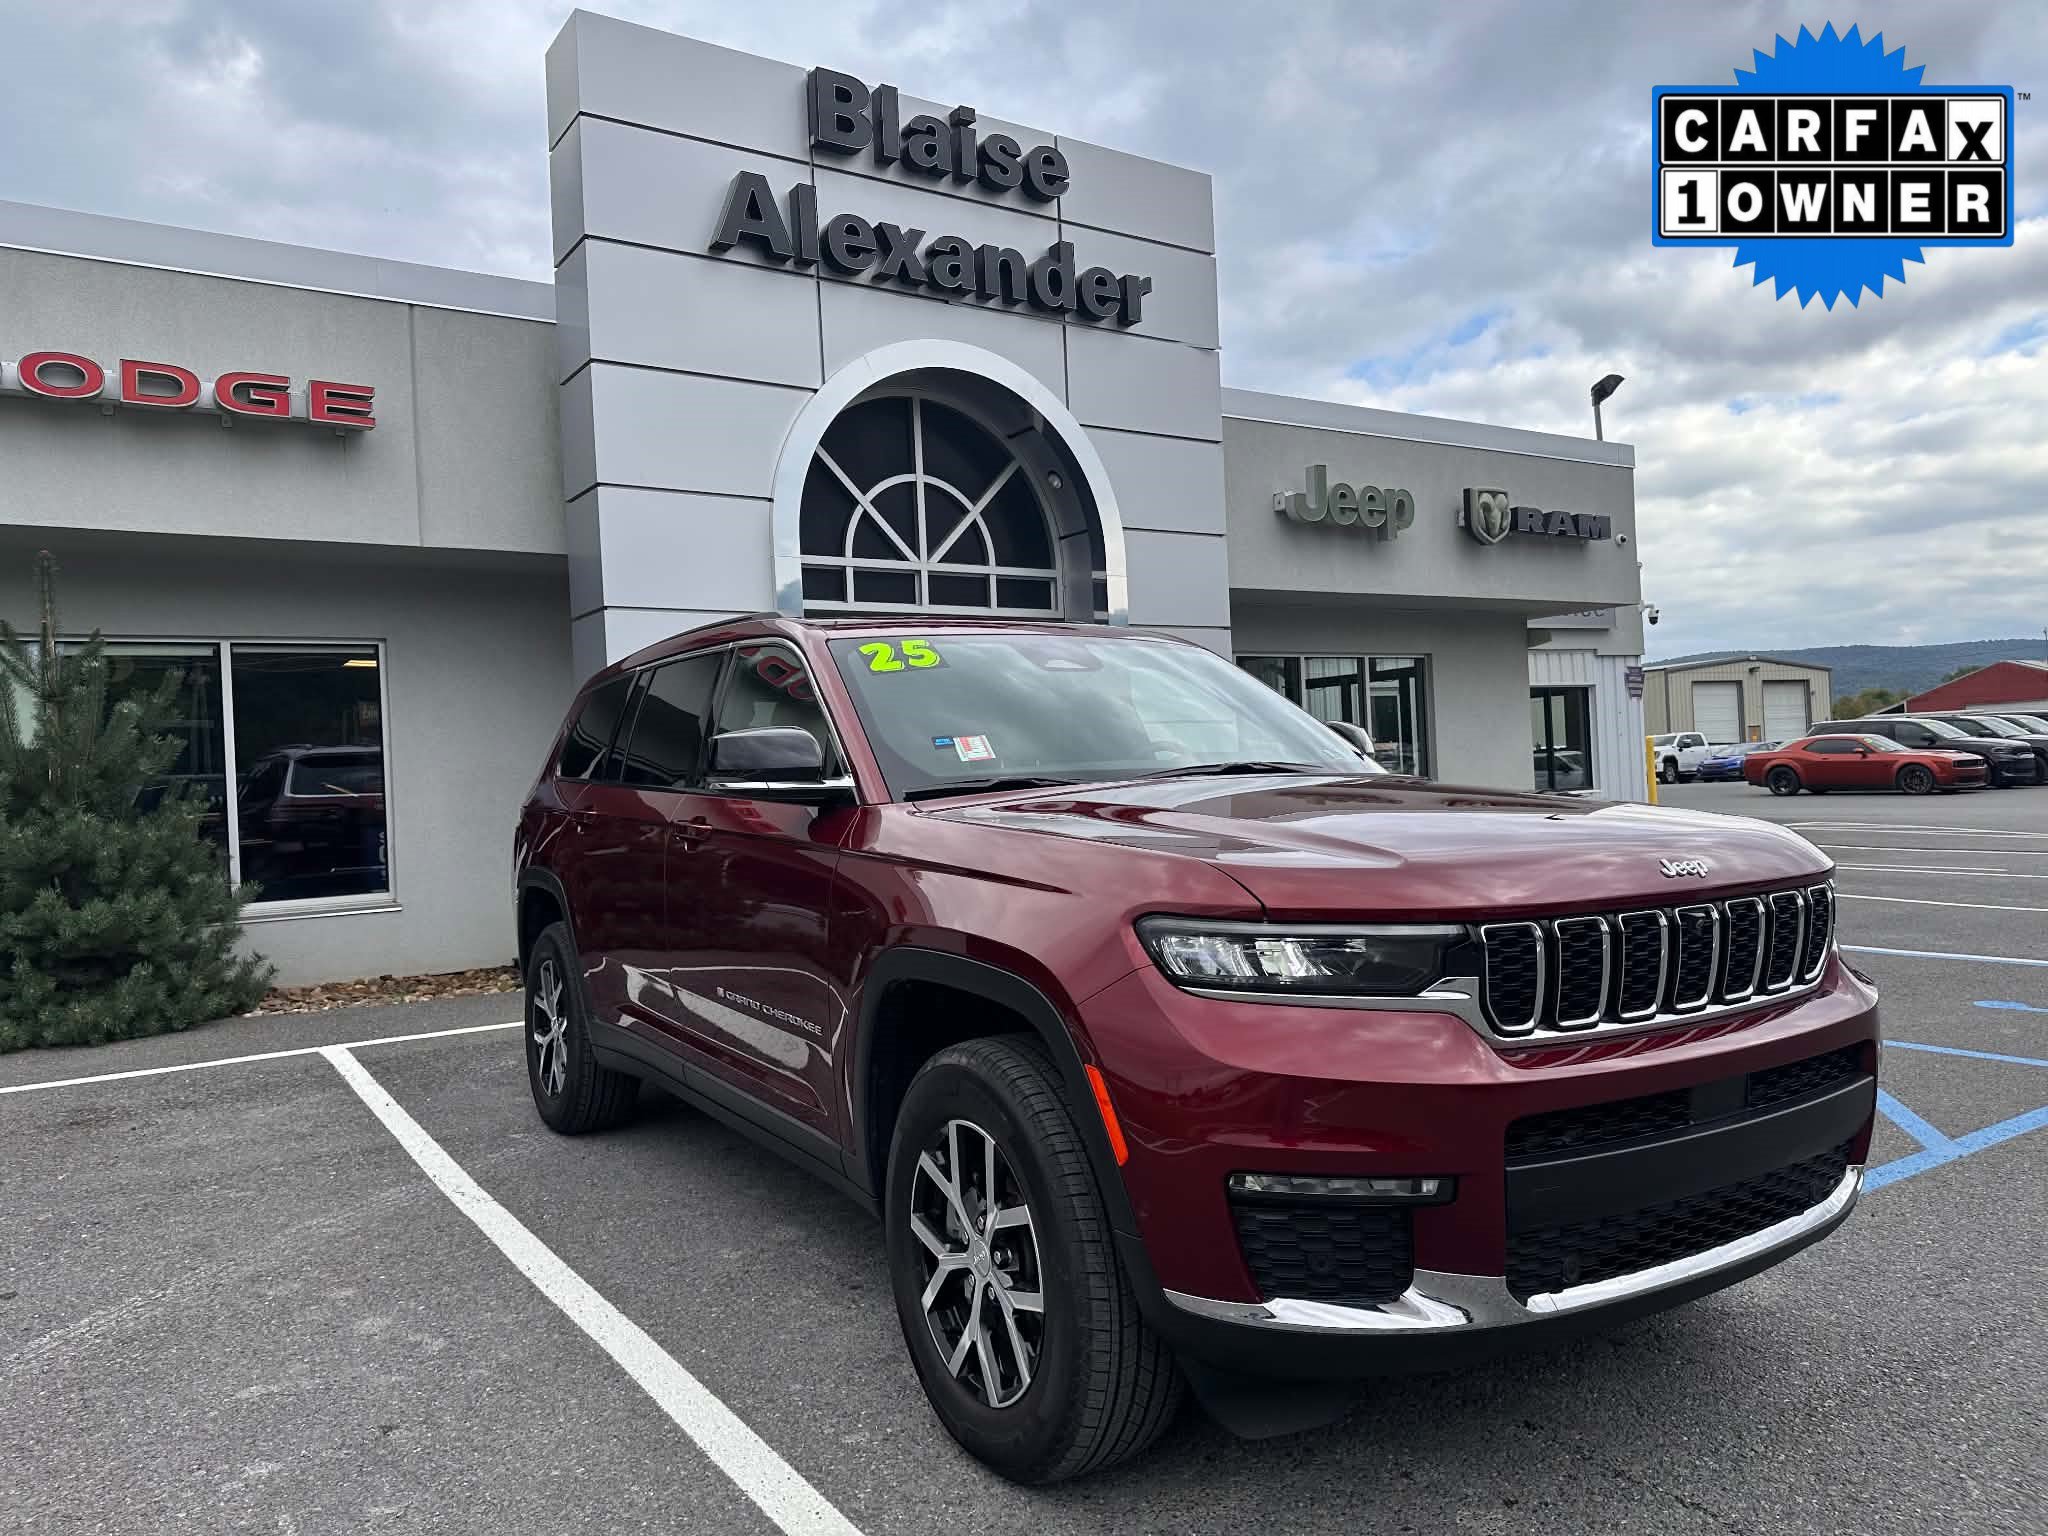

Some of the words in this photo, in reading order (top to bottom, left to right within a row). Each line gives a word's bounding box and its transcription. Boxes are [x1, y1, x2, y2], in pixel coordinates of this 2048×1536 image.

[808, 66, 1071, 201] Blaise
[710, 171, 1153, 327] Alexander
[0, 351, 376, 431] ODGE
[1285, 464, 1415, 541] Jeep
[1509, 506, 1612, 540] RAM
[859, 639, 940, 672] 25
[1659, 858, 1709, 878] Jeep
[725, 990, 760, 1011] GRAND
[761, 1004, 823, 1036] CHEROKEE
